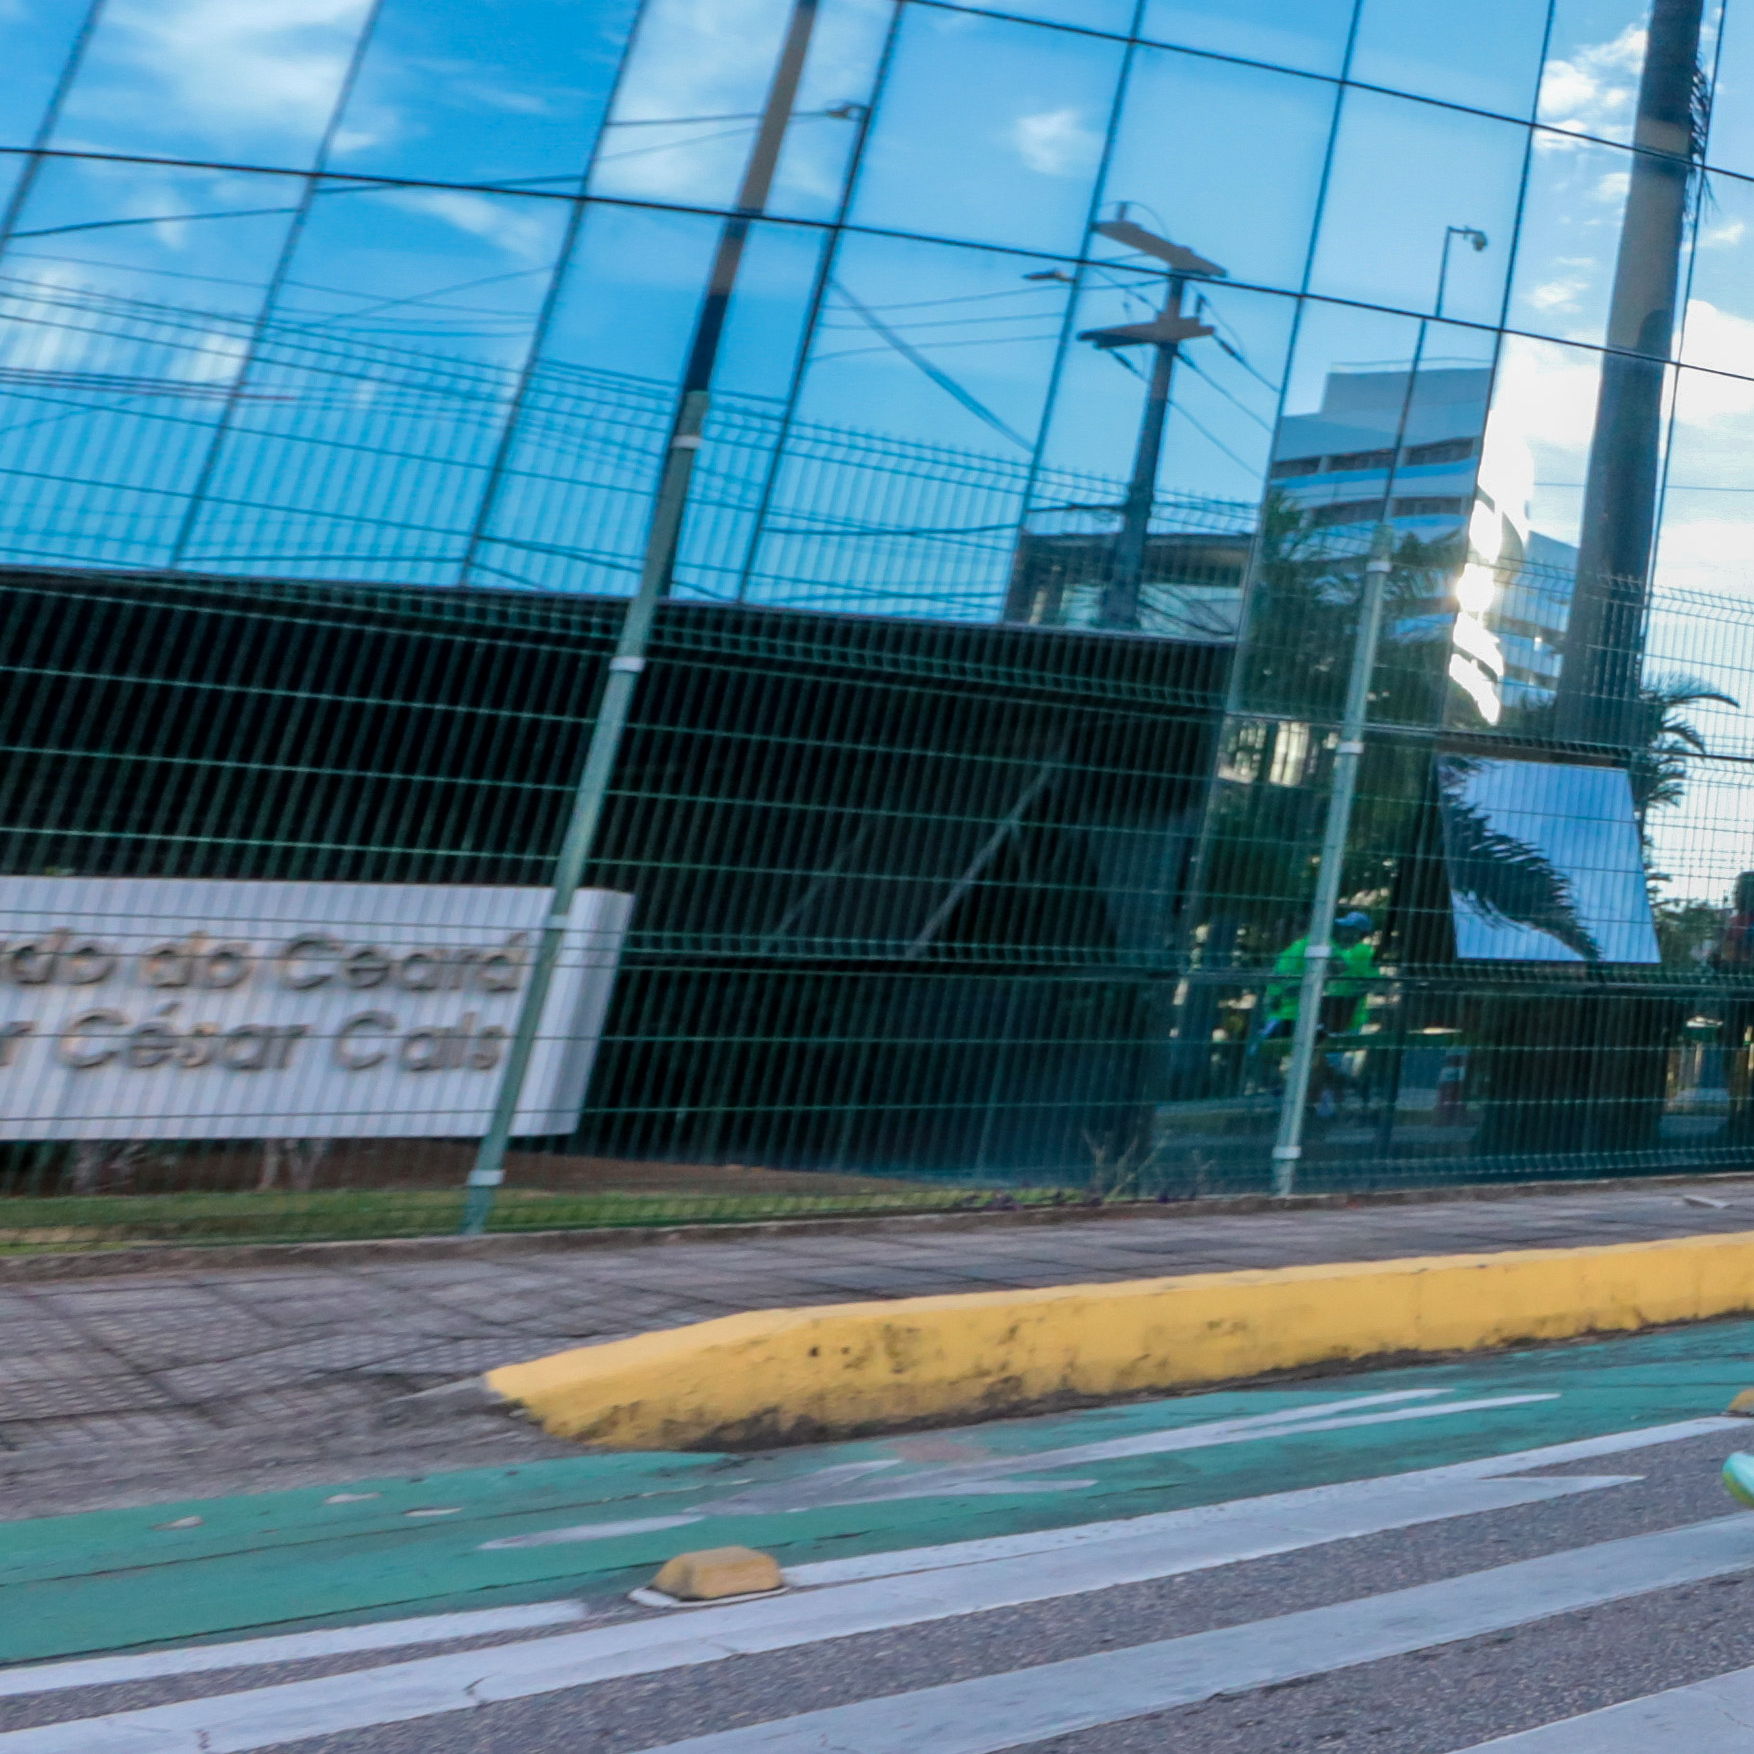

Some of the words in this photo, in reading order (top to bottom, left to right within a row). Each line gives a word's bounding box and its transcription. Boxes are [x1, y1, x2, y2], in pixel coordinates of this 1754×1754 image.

[0, 927, 118, 987] do
[143, 930, 253, 990] do
[58, 1000, 312, 1072] César
[334, 1009, 509, 1072] Cals
